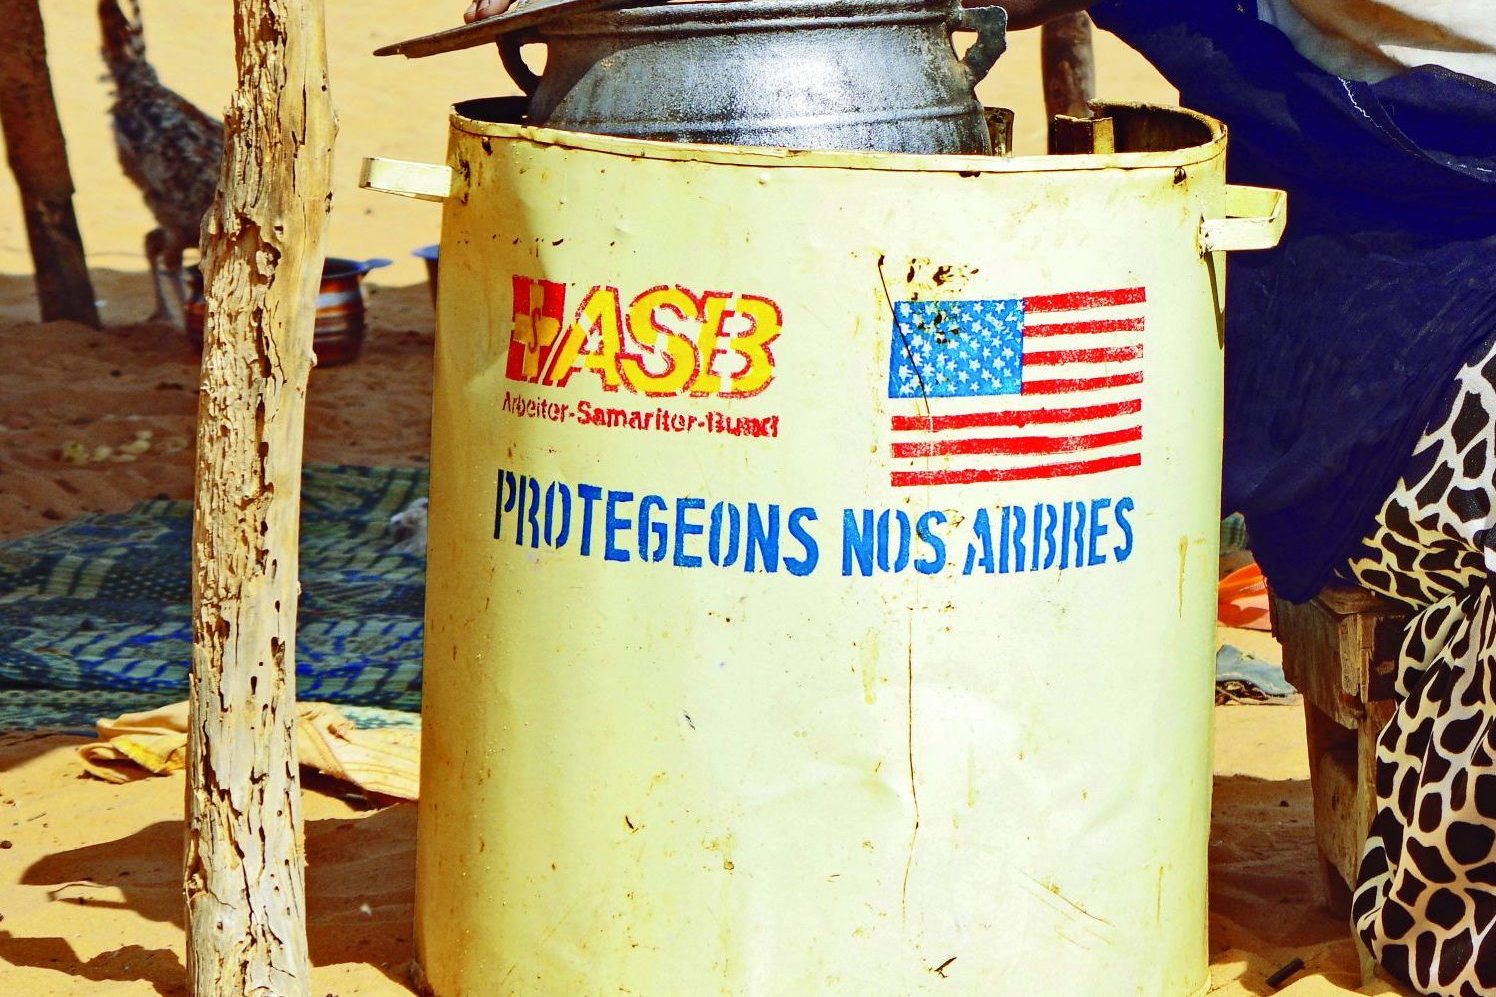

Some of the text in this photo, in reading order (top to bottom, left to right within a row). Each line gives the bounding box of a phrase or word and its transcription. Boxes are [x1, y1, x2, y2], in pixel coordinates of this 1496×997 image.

[541, 283, 784, 400] ASB
[493, 468, 1135, 577] PROTEGEONS NOS ARBRES
